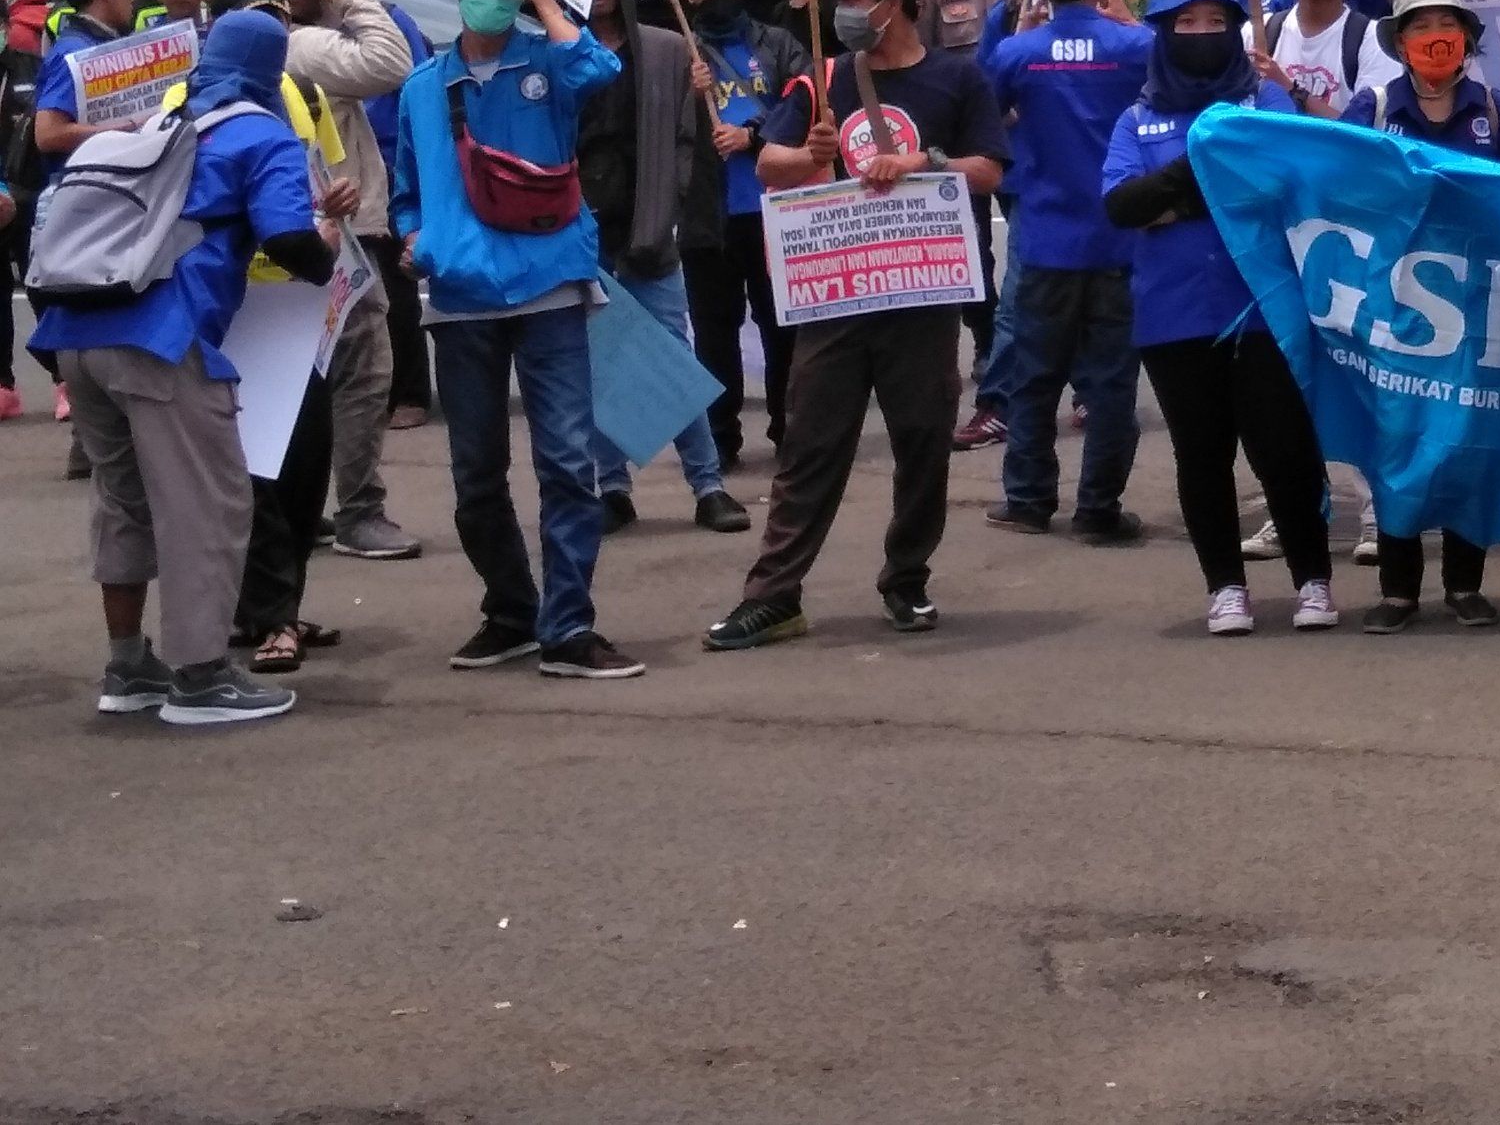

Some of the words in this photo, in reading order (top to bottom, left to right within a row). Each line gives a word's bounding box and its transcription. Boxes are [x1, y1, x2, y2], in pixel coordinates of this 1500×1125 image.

[82, 44, 155, 81] OMNIBUS
[159, 36, 191, 58] LAW
[1052, 39, 1093, 62] GSBI
[1137, 120, 1175, 136] GSBI
[852, 200, 905, 215] MENGUSIR
[908, 198, 926, 209] DAN
[811, 206, 850, 224] RAKYAT
[866, 215, 904, 227] SUMBER
[781, 229, 807, 243] (SDA)
[809, 224, 836, 238] ALAM
[823, 231, 880, 248] MONOPOLI
[882, 224, 963, 240] MELESTARIKAN
[783, 240, 820, 257] TANAH
[786, 256, 847, 280] LINGKUNGAN
[852, 263, 969, 294] OMNIBUS
[791, 277, 845, 306] LAW
[1368, 369, 1453, 402] SERIKAT
